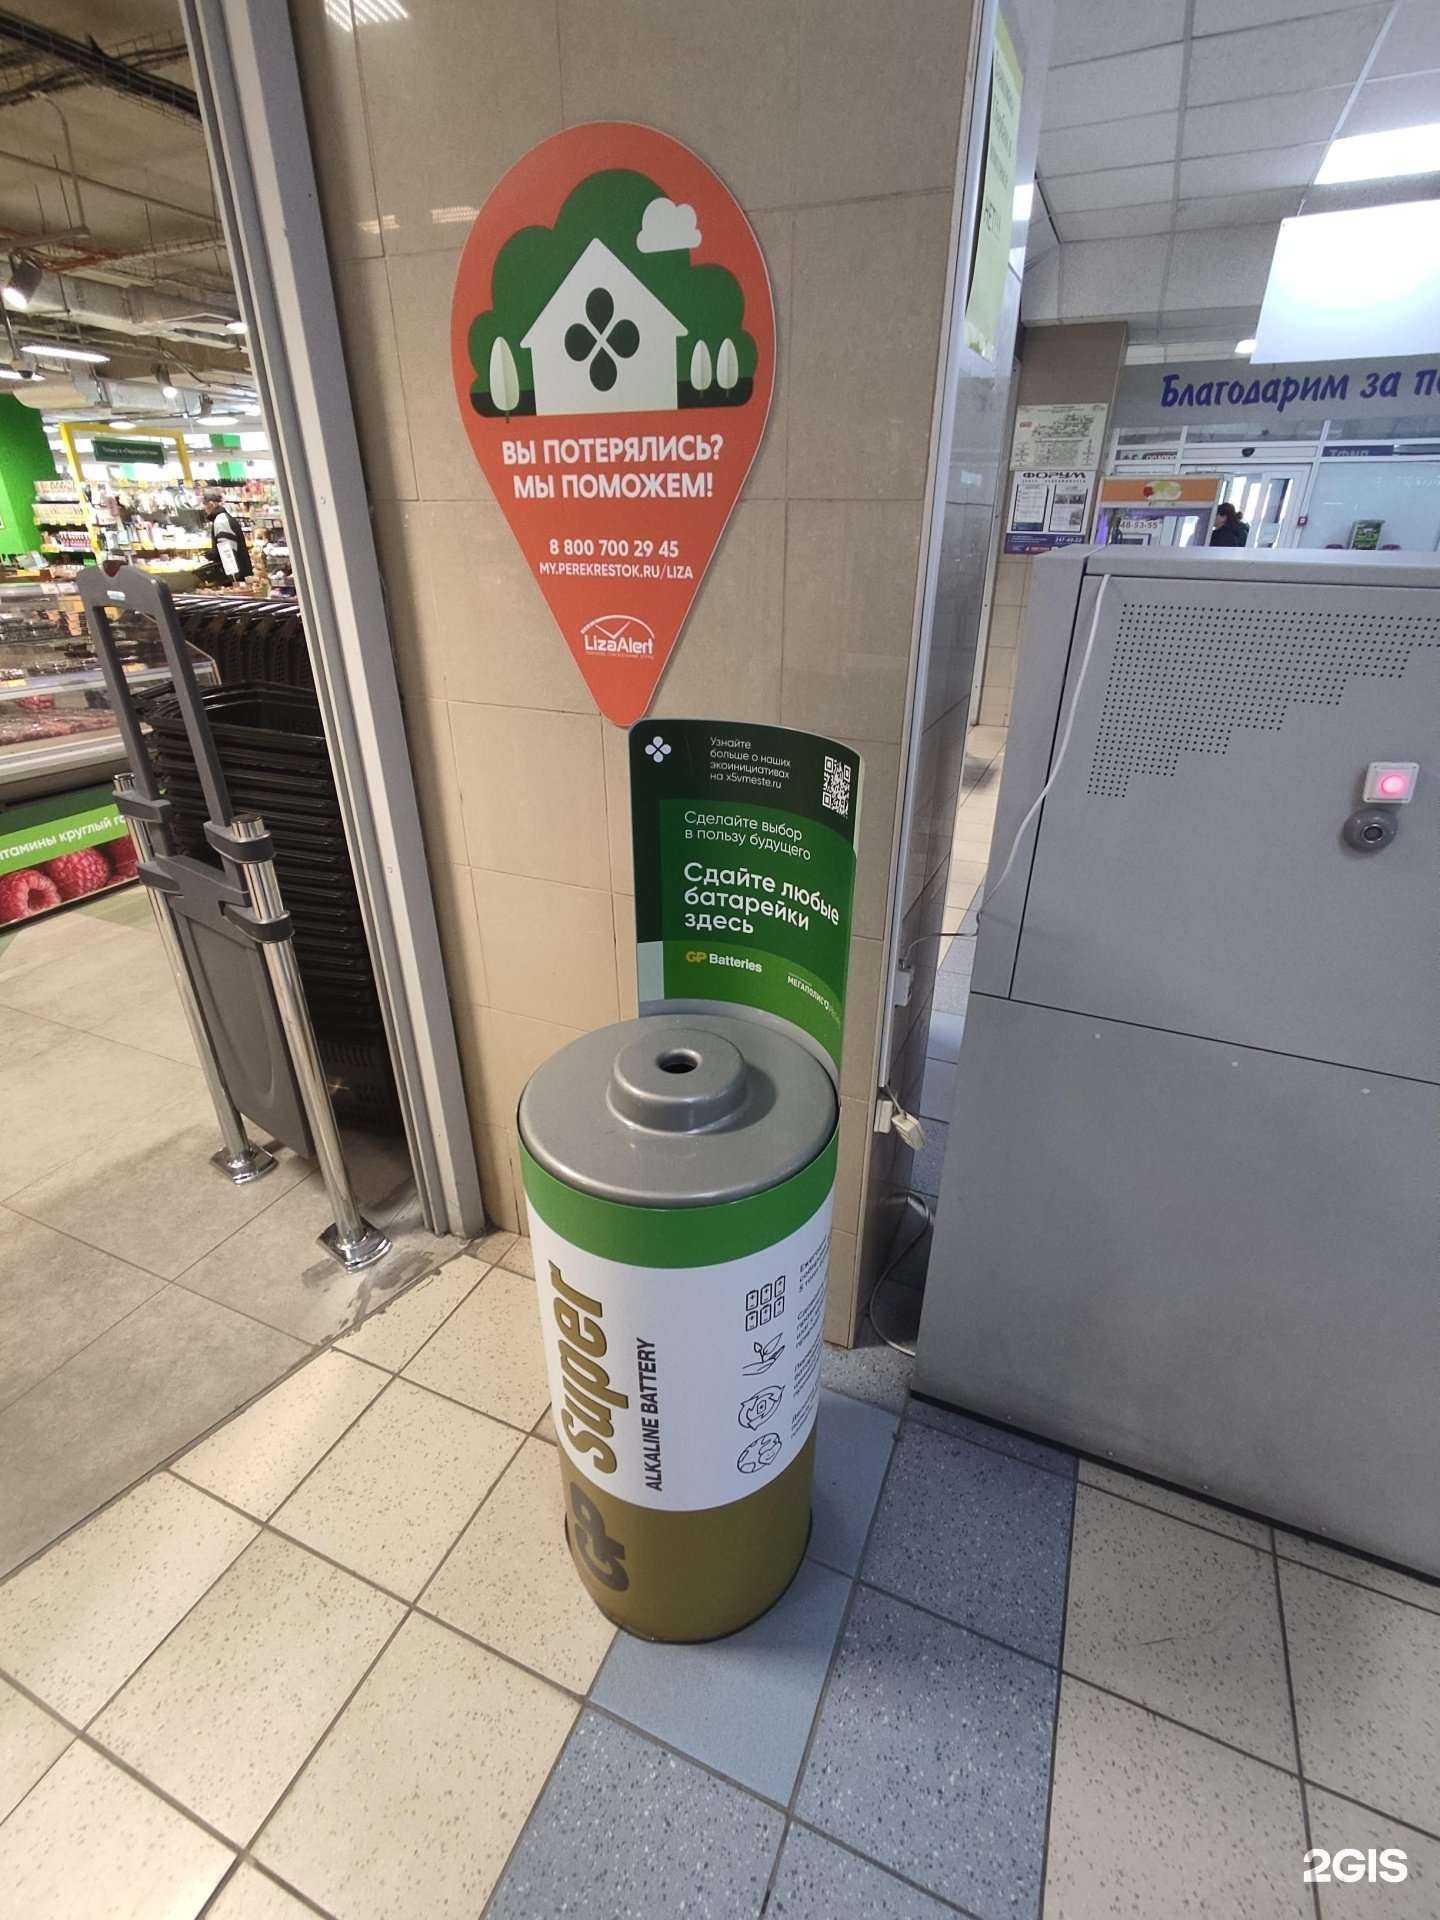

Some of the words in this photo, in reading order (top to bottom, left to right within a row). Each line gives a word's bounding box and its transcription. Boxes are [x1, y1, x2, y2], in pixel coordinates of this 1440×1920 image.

[1161, 374, 1350, 413] Благодарим
[1360, 371, 1402, 399] за
[1414, 369, 1440, 397] п
[502, 440, 536, 464] ВЫ
[543, 434, 724, 464] ПОТЕРЯЛИСЬ?
[513, 474, 554, 498] МЫ
[562, 472, 713, 498] ПОМОЖЕМ!
[549, 539, 559, 555] 8
[564, 539, 594, 556] 800
[598, 540, 629, 556] 700
[633, 541, 653, 557] 29
[658, 541, 679, 558] 45
[539, 562, 693, 579] MY.PEREKRESTOK.RU/LIZA
[584, 634, 653, 655] LizaAlert
[710, 736, 751, 749] Узнайте
[710, 749, 750, 761] больше
[751, 753, 759, 762] о
[760, 755, 792, 769] наших
[710, 761, 790, 780] экоинициативах
[710, 773, 724, 781] на
[726, 772, 782, 789] x5vmeste.ru
[0, 836, 57, 861] тамины
[59, 817, 112, 843] круглый
[113, 815, 127, 826] го
[684, 810, 758, 830] Сделайте
[761, 821, 803, 842] выбор
[685, 829, 693, 839] в
[697, 829, 746, 846] пользу
[749, 833, 811, 860] будущего
[683, 862, 776, 893] Сдайте
[780, 881, 840, 926] любые
[684, 886, 809, 931] батарейки
[684, 913, 754, 934] здесь
[686, 951, 707, 963] GP
[709, 953, 763, 973] Batteries
[548, 1259, 629, 1474] super
[636, 1337, 659, 1414] BATTERY
[641, 1417, 663, 1492] ALKALINE
